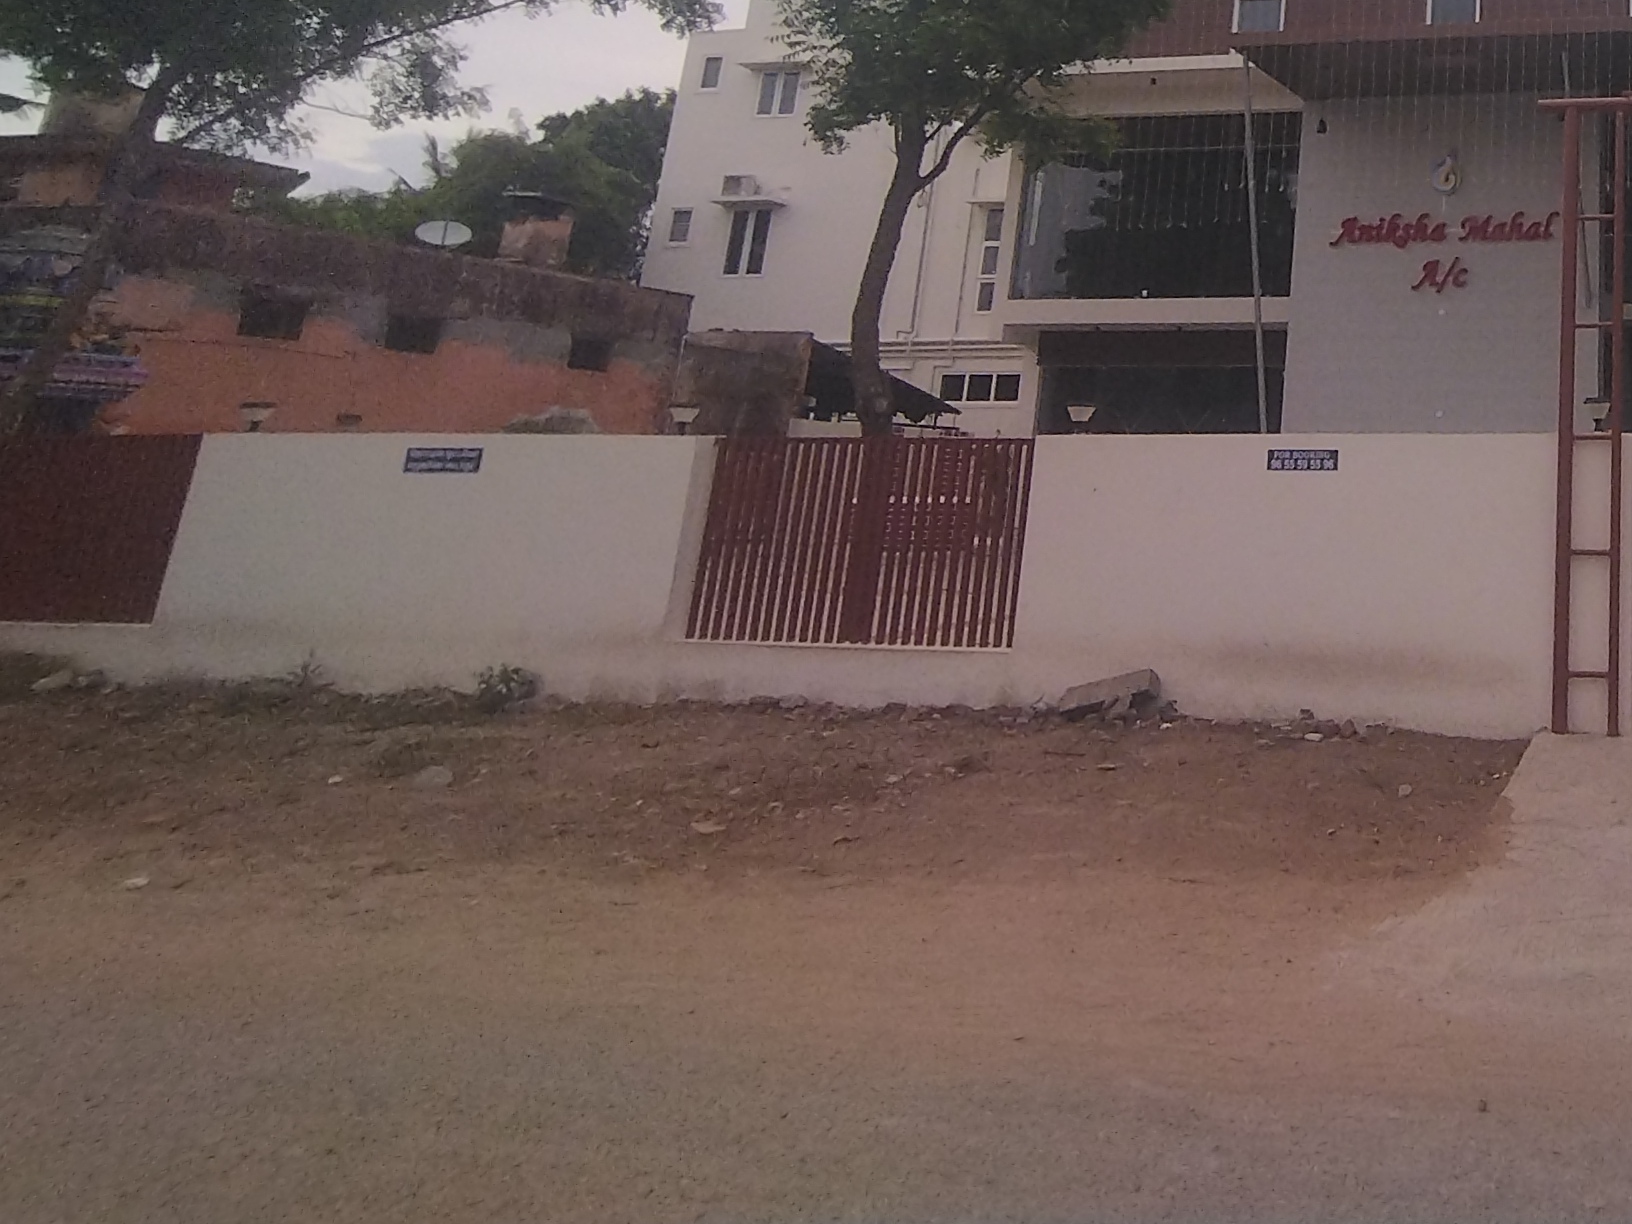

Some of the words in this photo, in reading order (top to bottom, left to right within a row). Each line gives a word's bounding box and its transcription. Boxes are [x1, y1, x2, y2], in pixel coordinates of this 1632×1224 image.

[1458, 211, 1560, 242] Mahal
[1273, 450, 1291, 459] FOR
[1292, 450, 1331, 459] BOOKING
